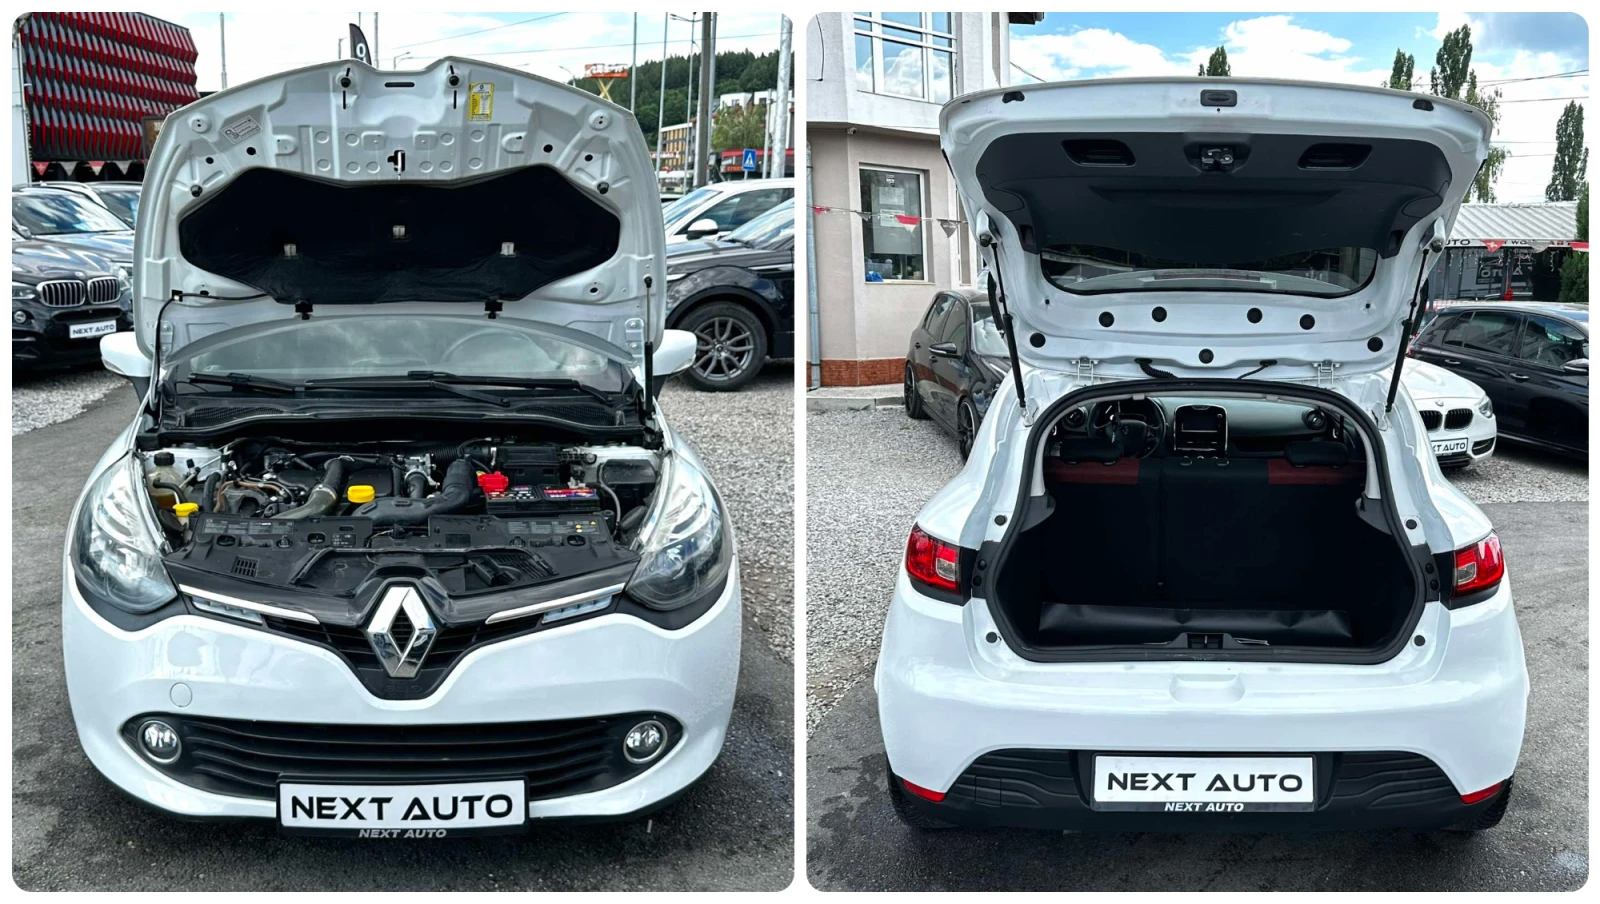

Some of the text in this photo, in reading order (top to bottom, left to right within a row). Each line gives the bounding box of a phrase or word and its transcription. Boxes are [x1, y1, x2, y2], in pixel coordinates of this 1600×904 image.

[72, 324, 115, 336] NEXT AUTO
[1443, 442, 1466, 452] AUTO
[1108, 772, 1303, 792] NEXT AUTO
[292, 793, 513, 821] NEXT AUTO
[1164, 802, 1245, 812] NEXT AUTO
[358, 828, 447, 839] NEXT AUTO
